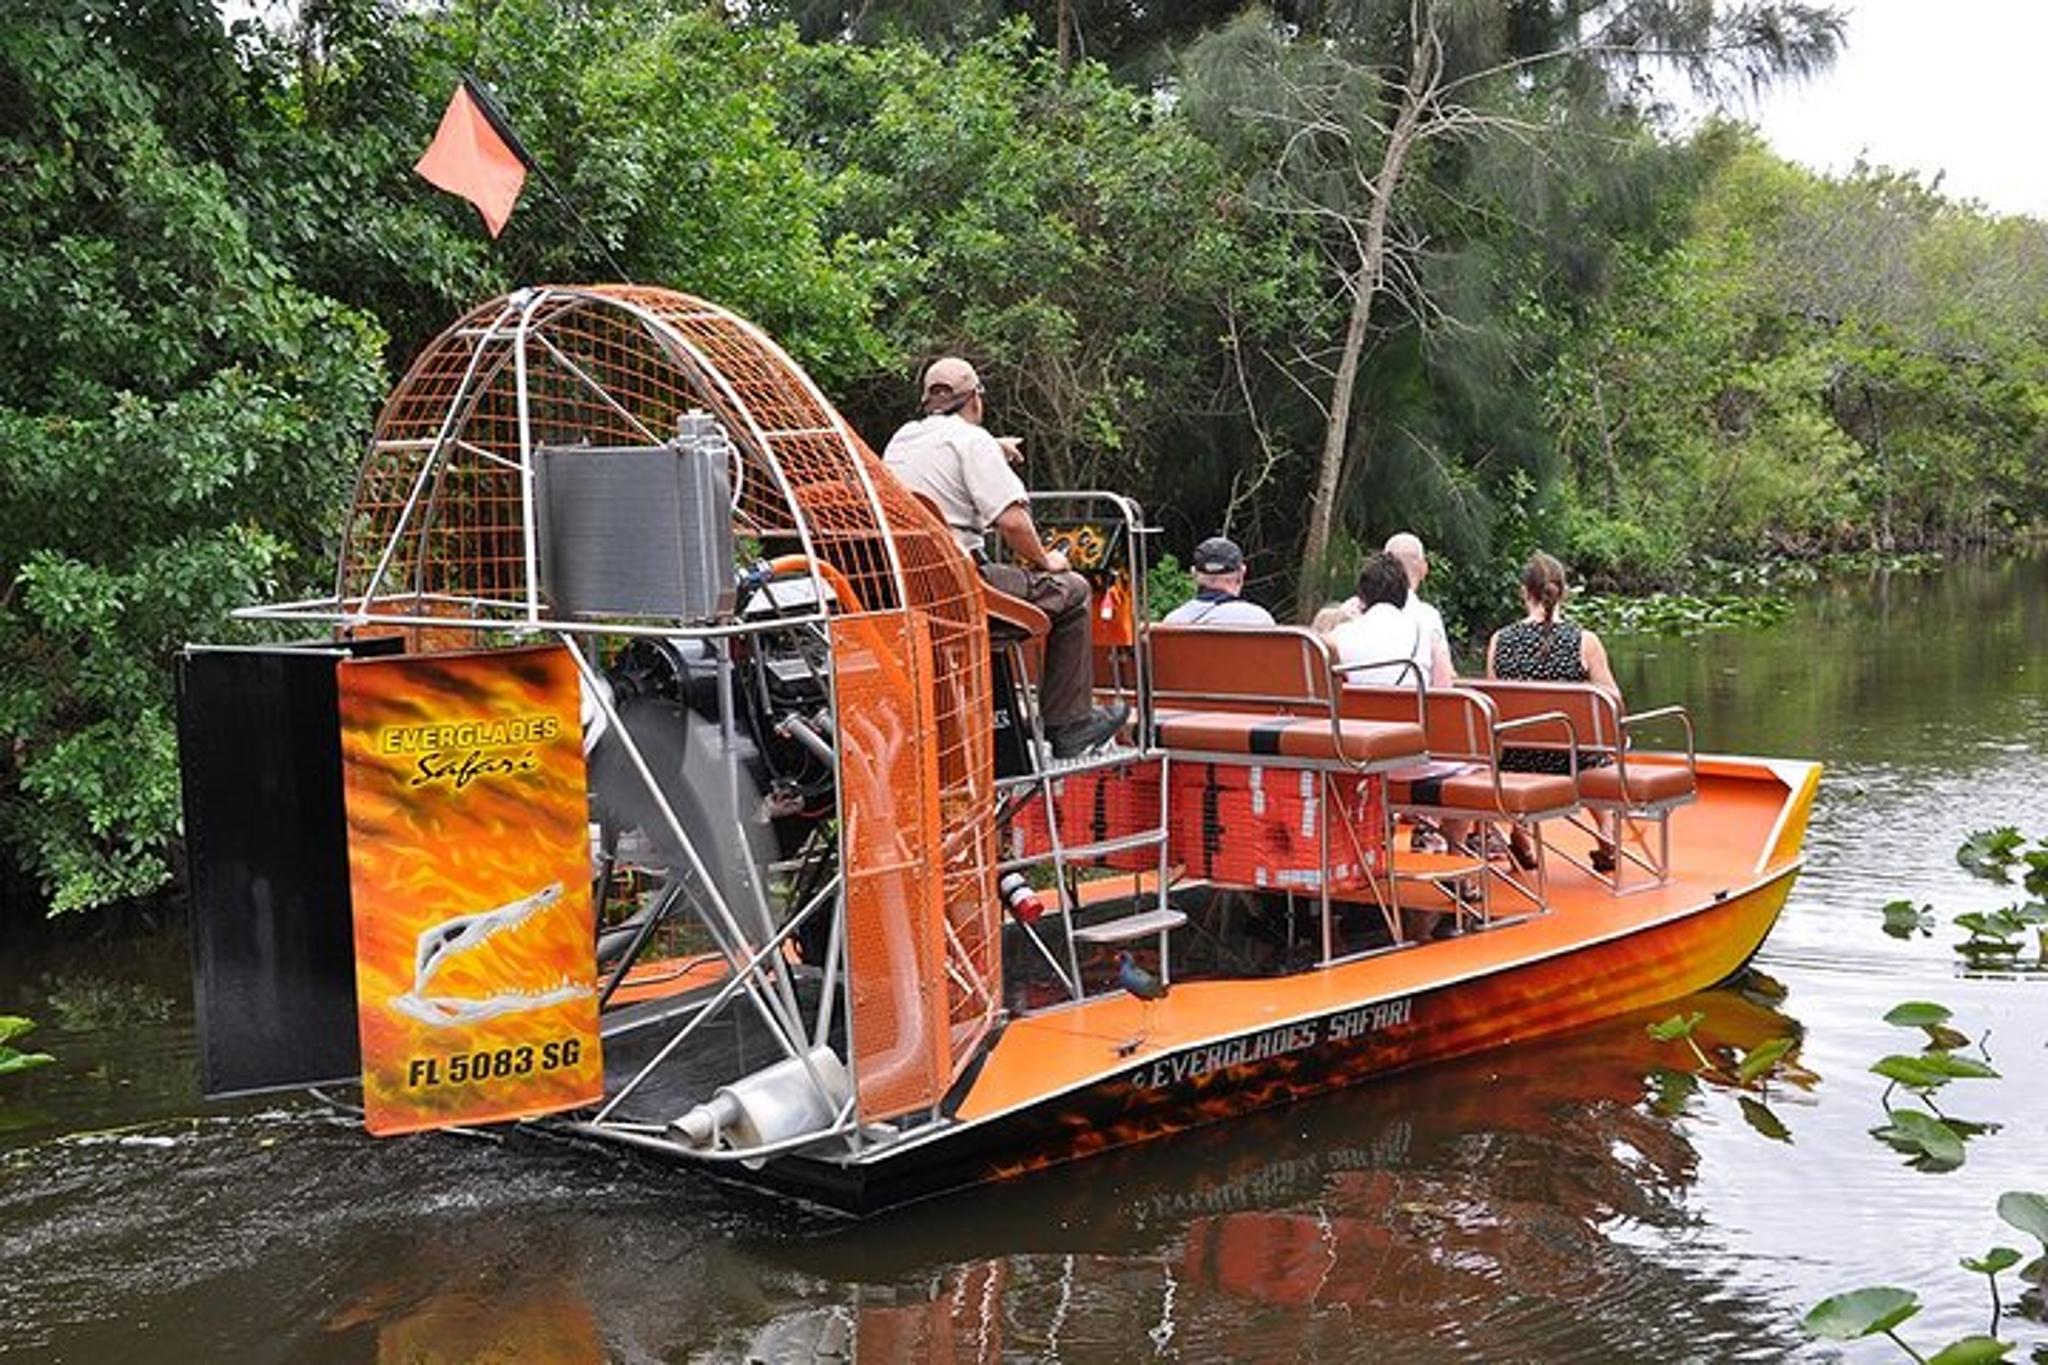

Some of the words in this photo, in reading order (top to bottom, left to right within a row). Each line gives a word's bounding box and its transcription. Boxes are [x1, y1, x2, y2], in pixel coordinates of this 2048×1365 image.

[383, 716, 558, 754] EVERGLADES
[411, 750, 536, 788] Safari
[409, 1059, 440, 1087] FL
[450, 1046, 534, 1083] 5083
[542, 1038, 581, 1070] SG
[1151, 1022, 1318, 1090] EVERGLADES
[1328, 998, 1412, 1041] SAFARI
